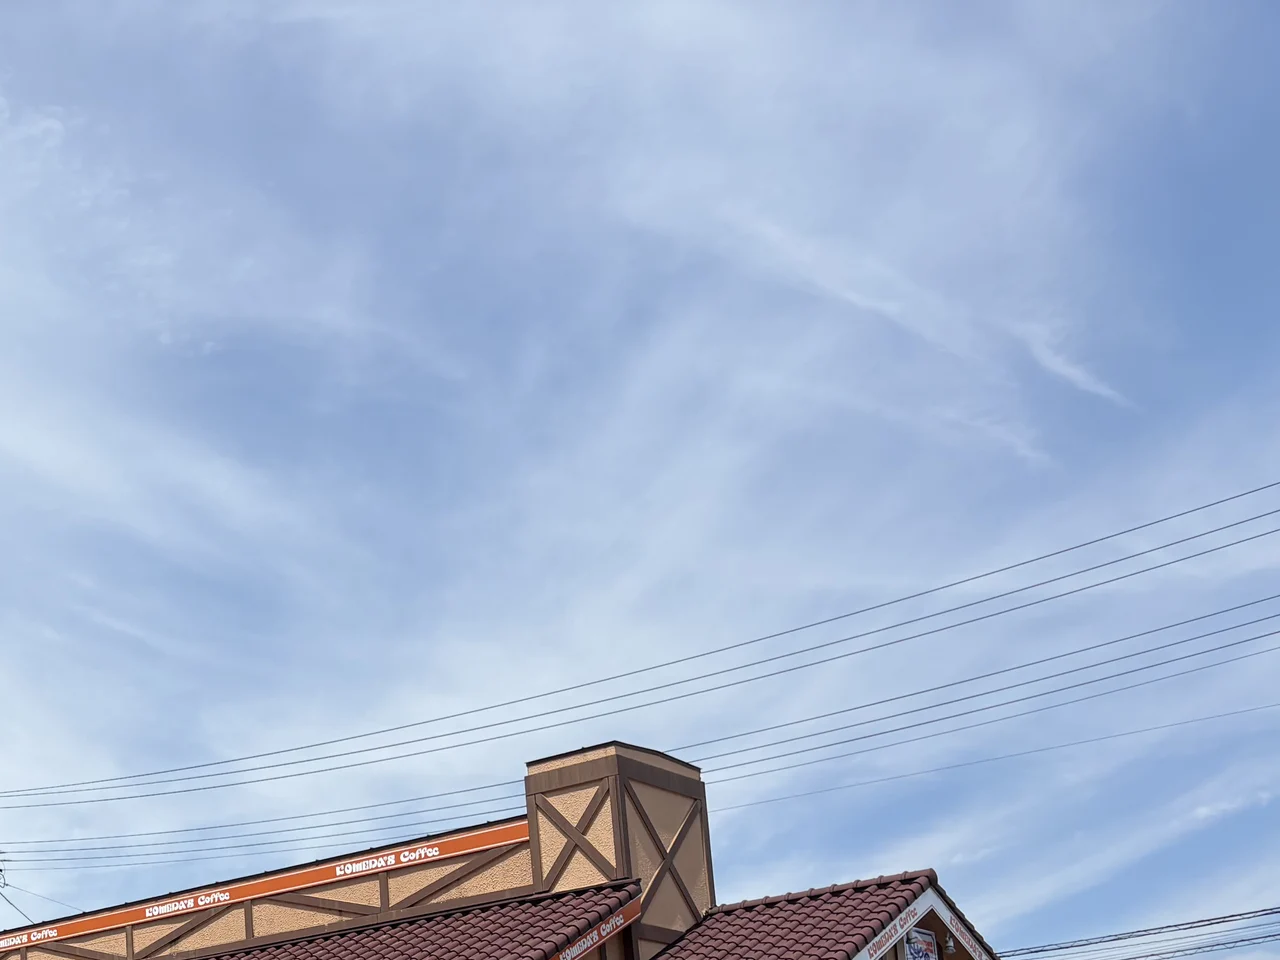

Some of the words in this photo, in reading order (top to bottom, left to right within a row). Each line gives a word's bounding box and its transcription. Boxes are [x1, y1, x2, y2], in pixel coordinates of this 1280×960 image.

[335, 854, 396, 877] KOMEDA'S
[399, 846, 440, 863] Coffee
[145, 897, 195, 918] KOMEDA'S
[197, 891, 231, 907] Coffee
[599, 913, 625, 936] Coffee
[898, 907, 918, 929] Coffee
[30, 928, 58, 943] Coffee
